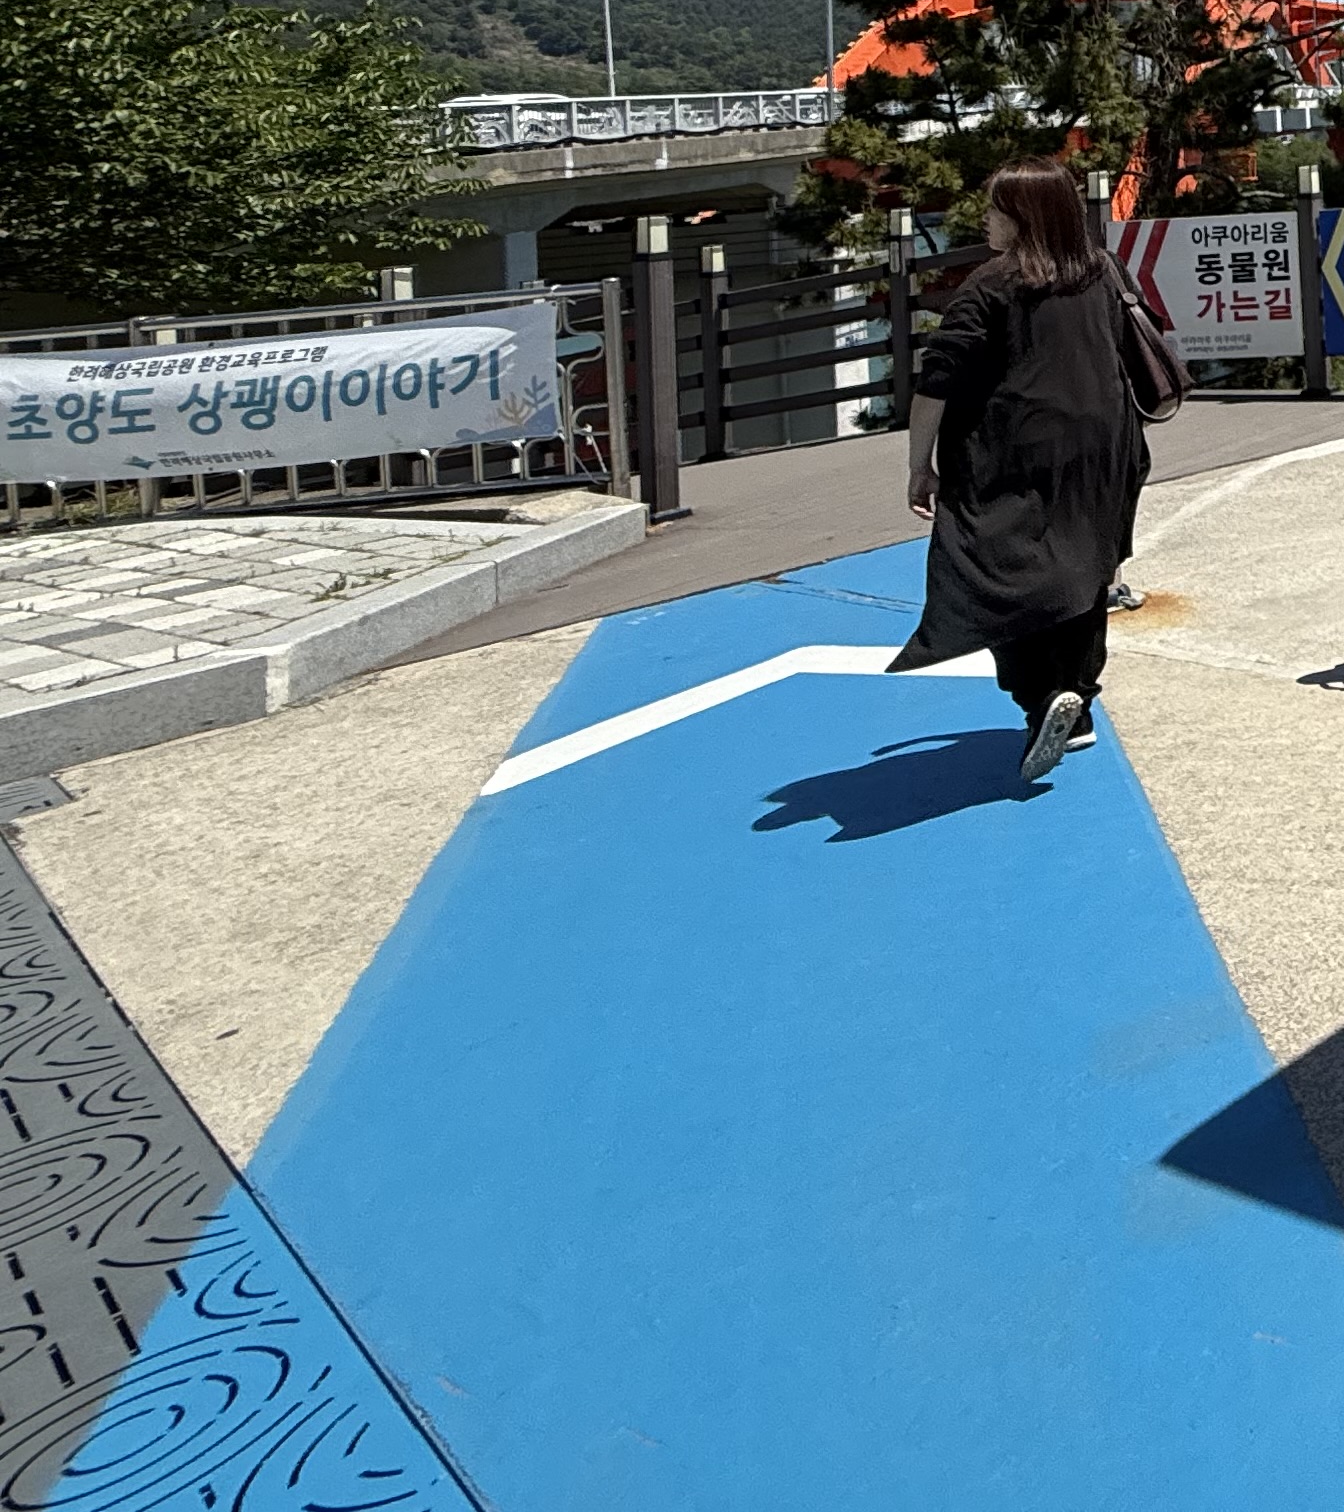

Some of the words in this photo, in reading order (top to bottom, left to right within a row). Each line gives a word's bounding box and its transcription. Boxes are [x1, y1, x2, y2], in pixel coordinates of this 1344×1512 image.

[1191, 221, 1289, 248] 아쿠아리움
[1194, 248, 1292, 286] 동물원
[1196, 287, 1293, 323] 가는길
[66, 357, 195, 382] 한려해상국립공원
[198, 345, 329, 373] 환경교육프로그램
[7, 386, 156, 445] 초양도
